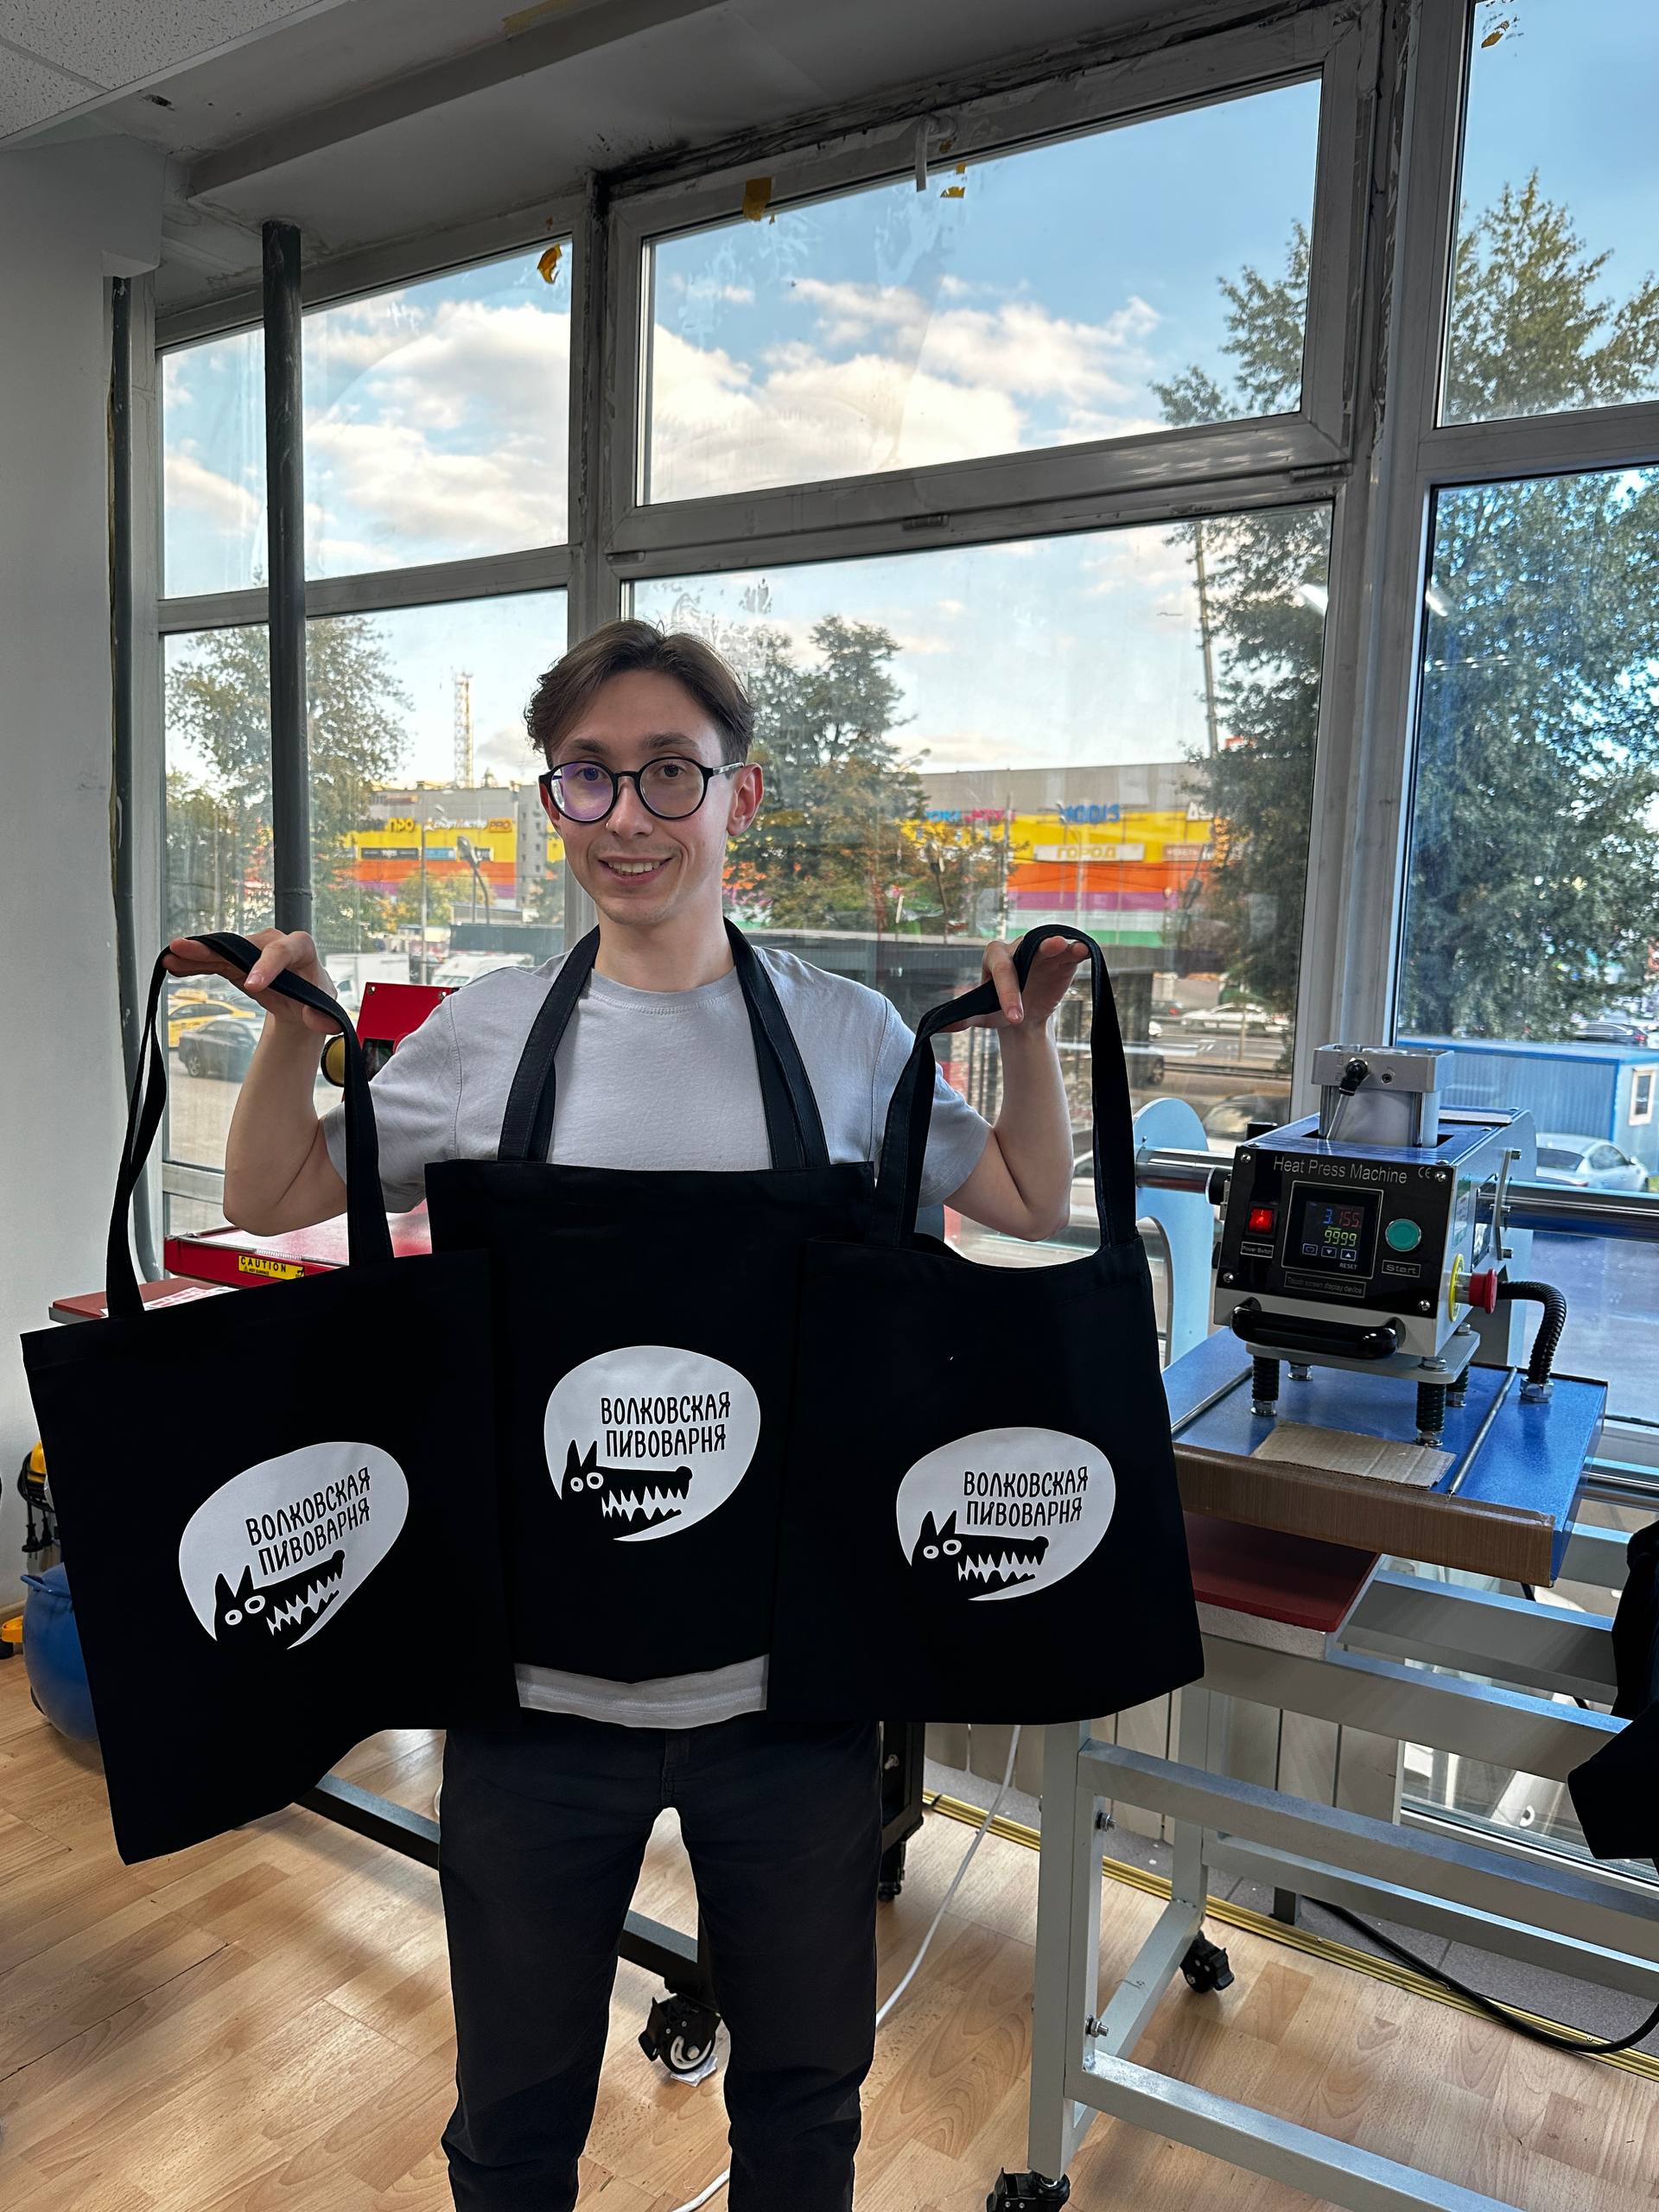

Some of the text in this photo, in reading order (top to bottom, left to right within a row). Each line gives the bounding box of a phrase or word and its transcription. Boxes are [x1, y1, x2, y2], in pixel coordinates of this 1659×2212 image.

[1057, 846, 1117, 859] ГОРОД
[1274, 1156, 1408, 1184] Heat Press Machine
[1324, 1230, 1357, 1247] 9999
[240, 1256, 287, 1273] CAUTION
[1386, 1264, 1416, 1274] Start
[1344, 1285, 1363, 1294] device
[601, 1391, 730, 1425] ВОЛКОВСКАЯ
[607, 1424, 726, 1458] ПИВОВАРНЯ
[963, 1466, 1088, 1497] ВОЛКОВСКАЯ
[245, 1466, 370, 1546] ВОЛКОВСКАЯ
[967, 1497, 1082, 1527] ПИВОВАРНЯ
[258, 1497, 370, 1575] ПИВОВАРНЯ
